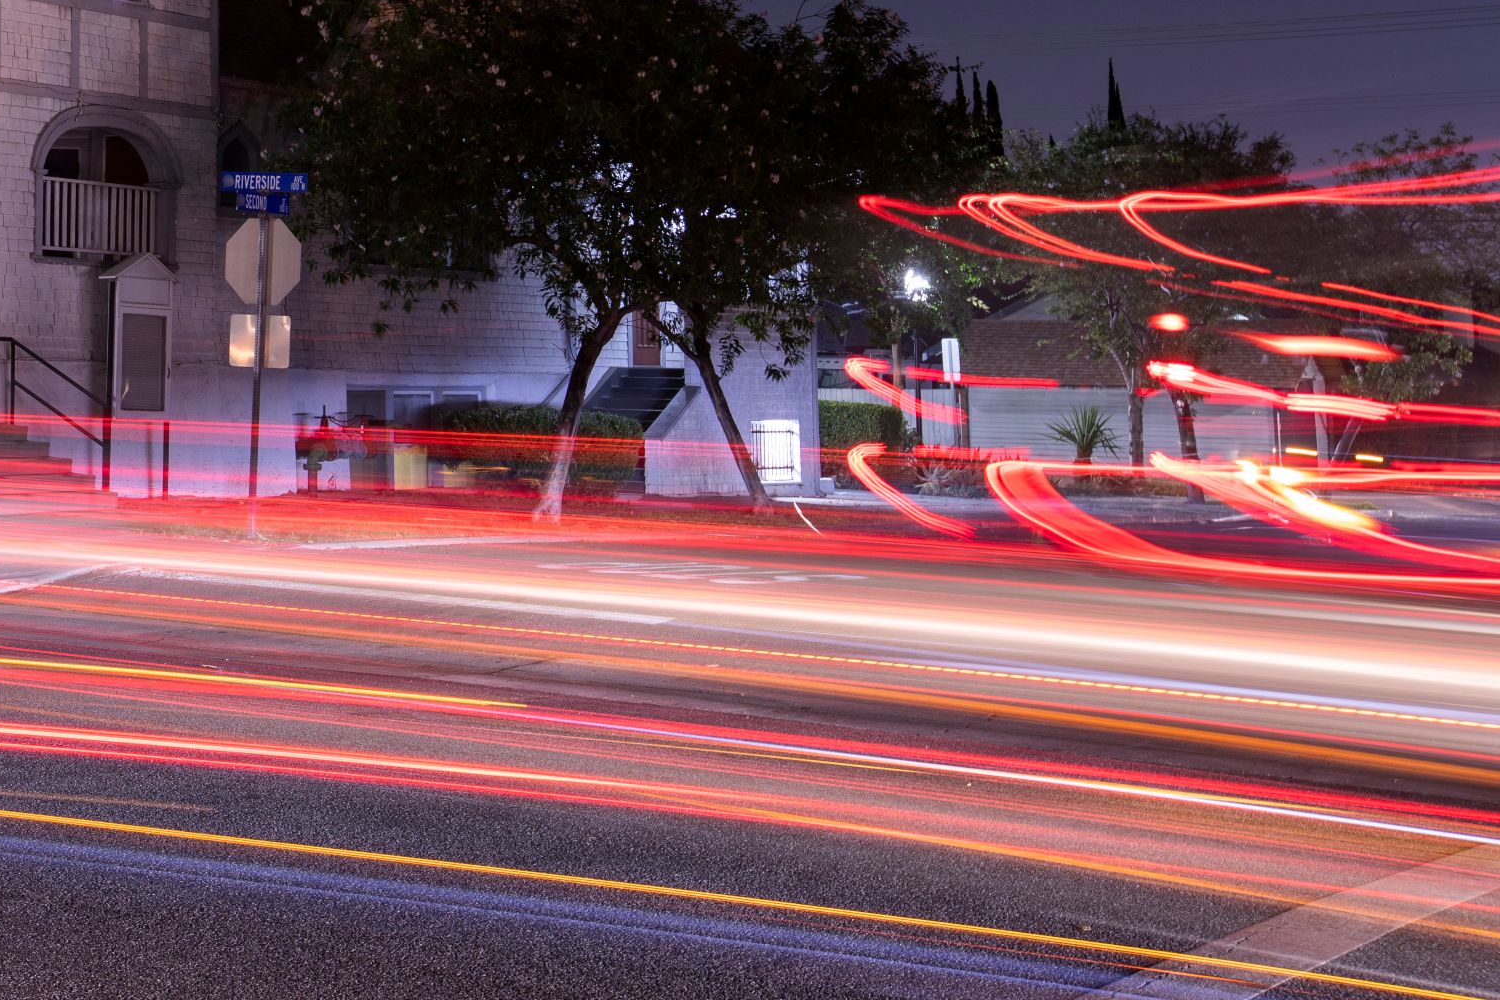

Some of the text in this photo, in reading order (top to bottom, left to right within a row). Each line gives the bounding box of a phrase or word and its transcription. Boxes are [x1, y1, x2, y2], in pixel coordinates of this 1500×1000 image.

[234, 174, 303, 190] RIVERSIDE AVE
[290, 182, 300, 191] 100
[245, 193, 268, 211] SECOND
